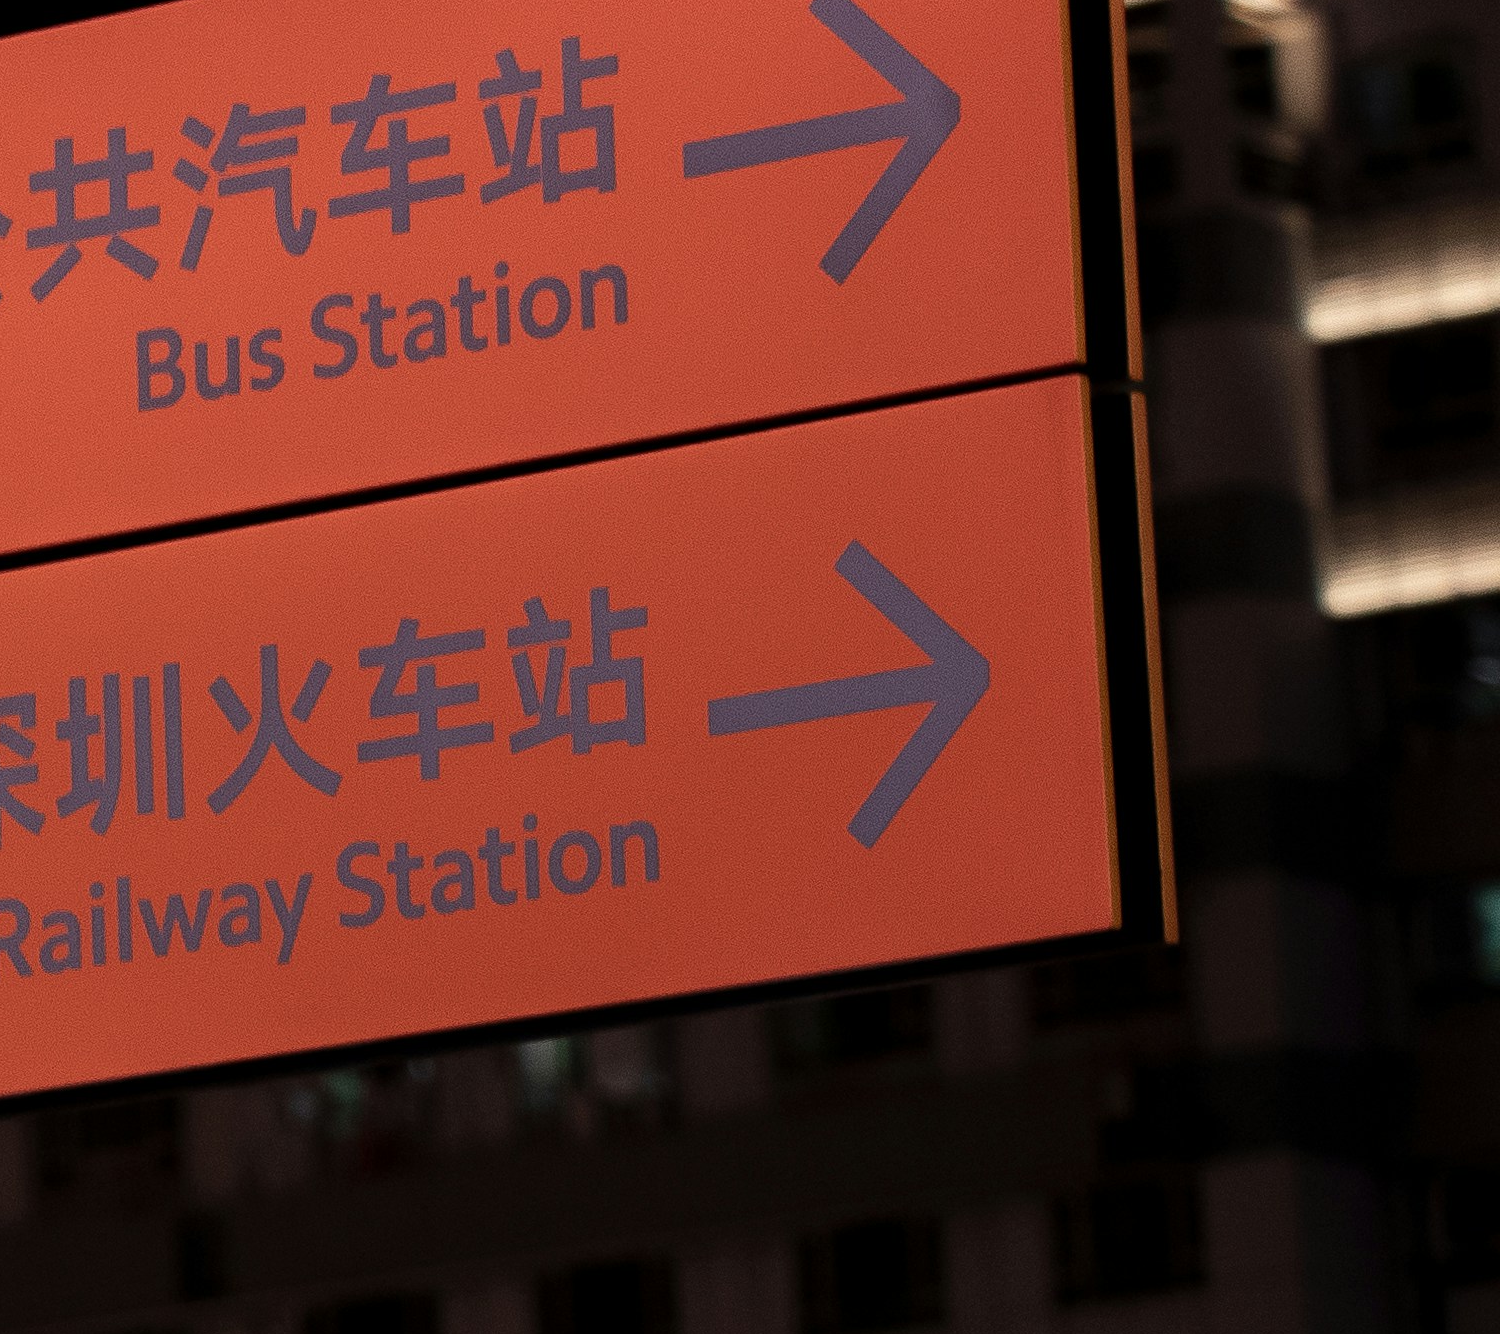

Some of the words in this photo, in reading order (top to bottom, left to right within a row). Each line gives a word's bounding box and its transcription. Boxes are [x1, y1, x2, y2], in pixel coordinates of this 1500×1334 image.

[134, 325, 287, 413] Bus
[309, 259, 630, 380] Station
[336, 812, 662, 929] Station
